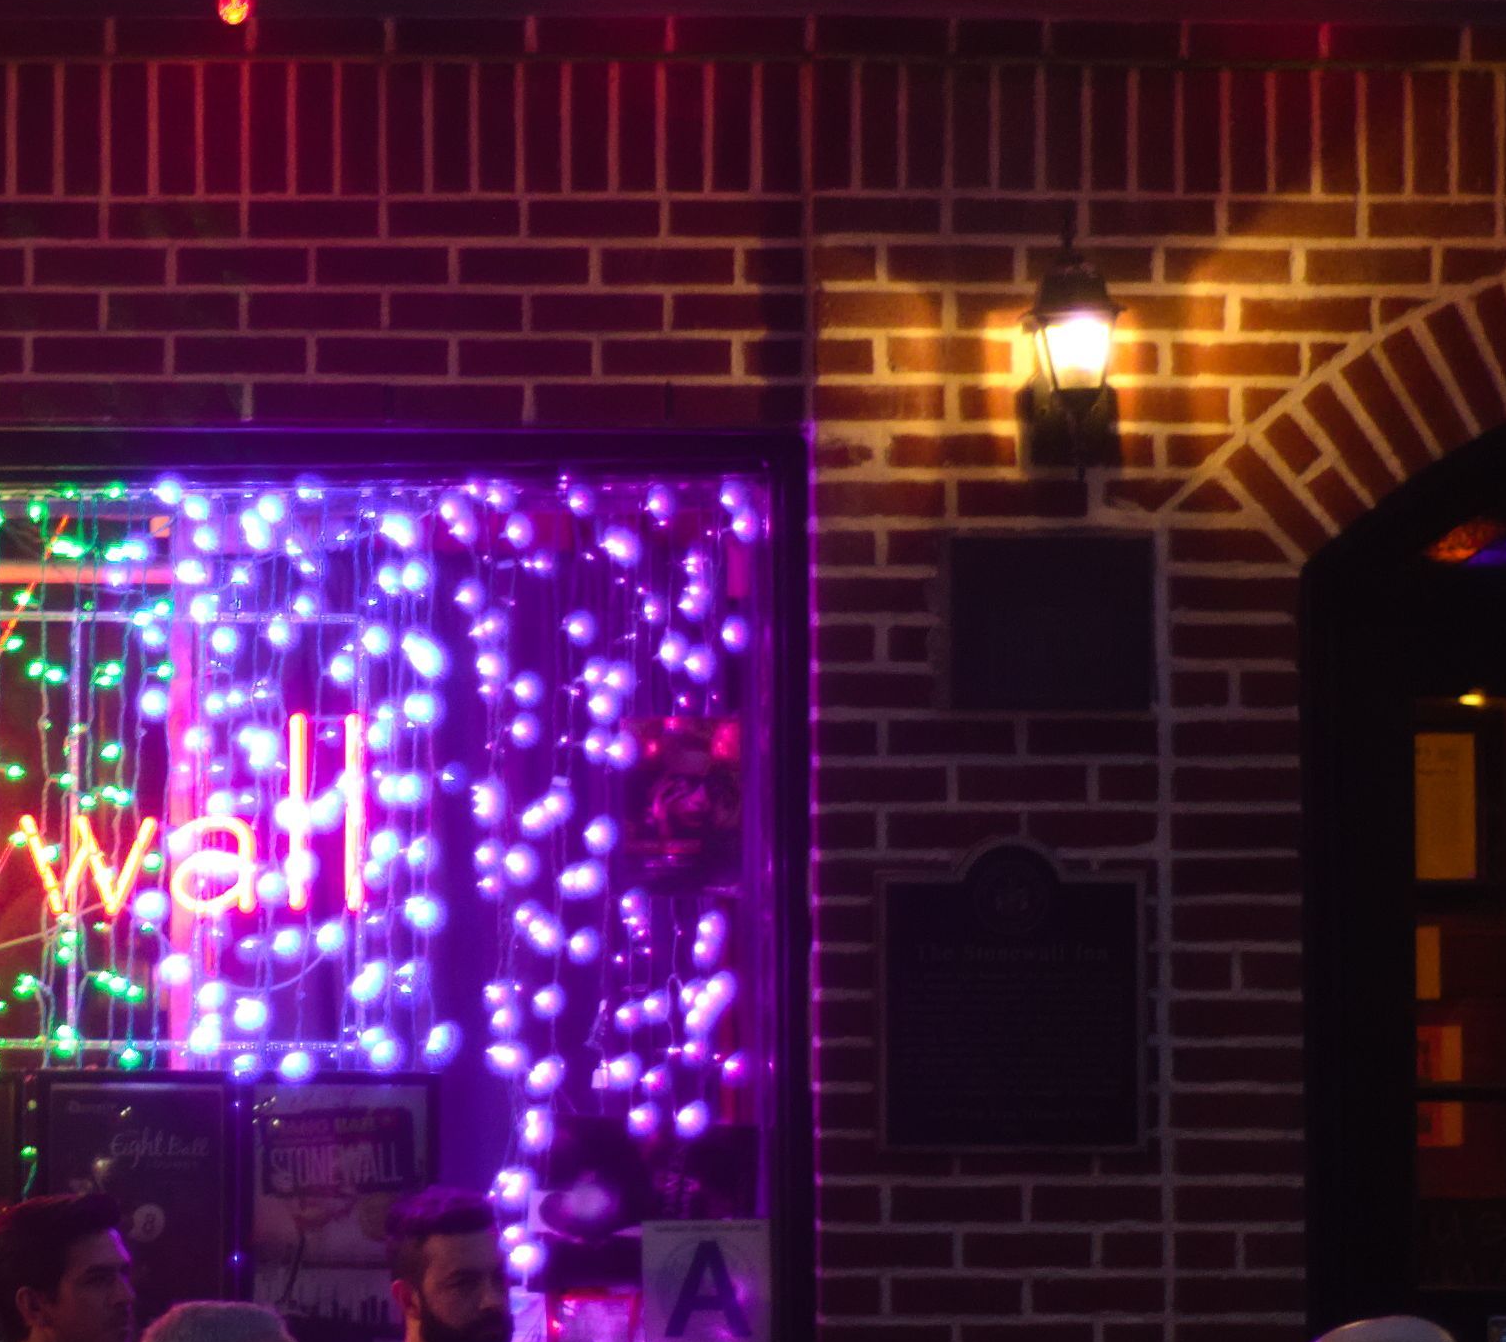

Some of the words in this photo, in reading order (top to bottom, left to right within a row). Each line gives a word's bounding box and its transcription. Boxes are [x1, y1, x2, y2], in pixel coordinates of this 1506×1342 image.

[962, 943, 1068, 963] Stonewall
[269, 1141, 404, 1187] STONEWALL
[665, 1240, 752, 1338] A
